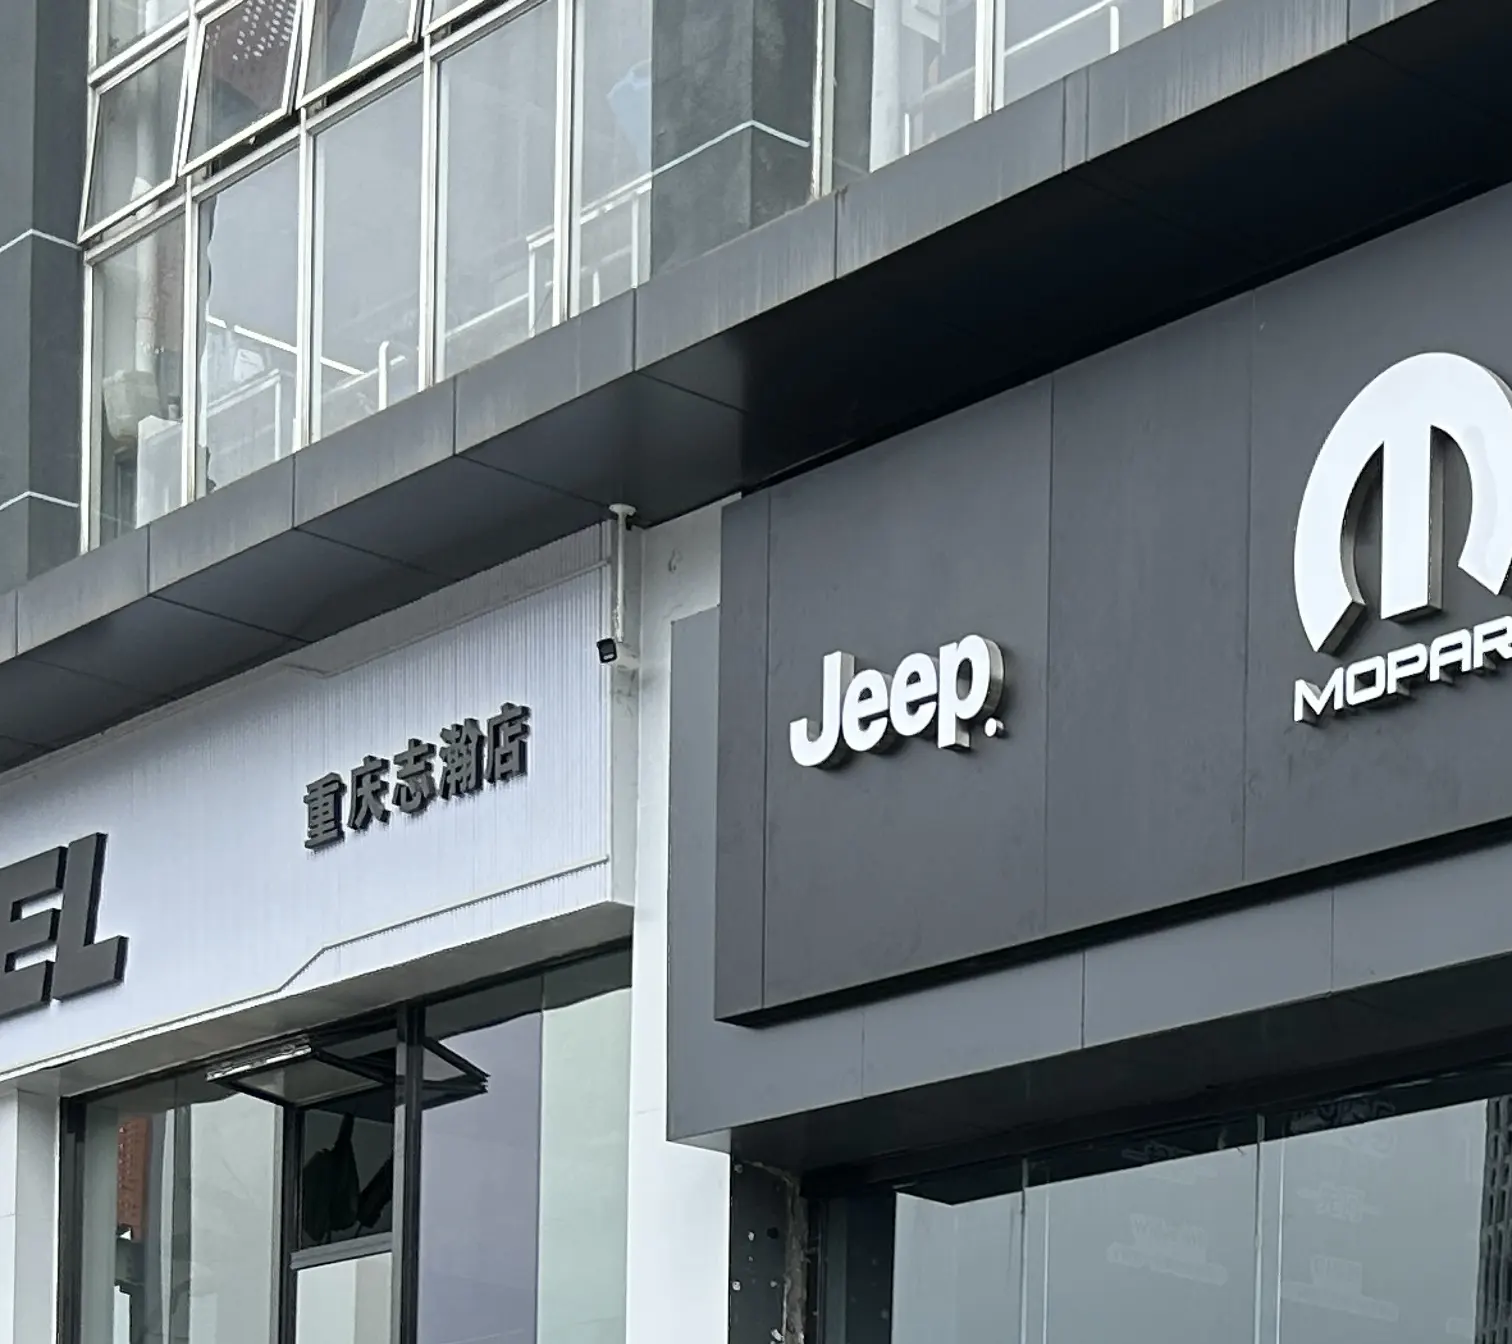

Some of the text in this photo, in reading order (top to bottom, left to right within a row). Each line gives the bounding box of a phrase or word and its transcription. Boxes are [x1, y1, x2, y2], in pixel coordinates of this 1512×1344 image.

[303, 701, 531, 851] 重庆志瀚店
